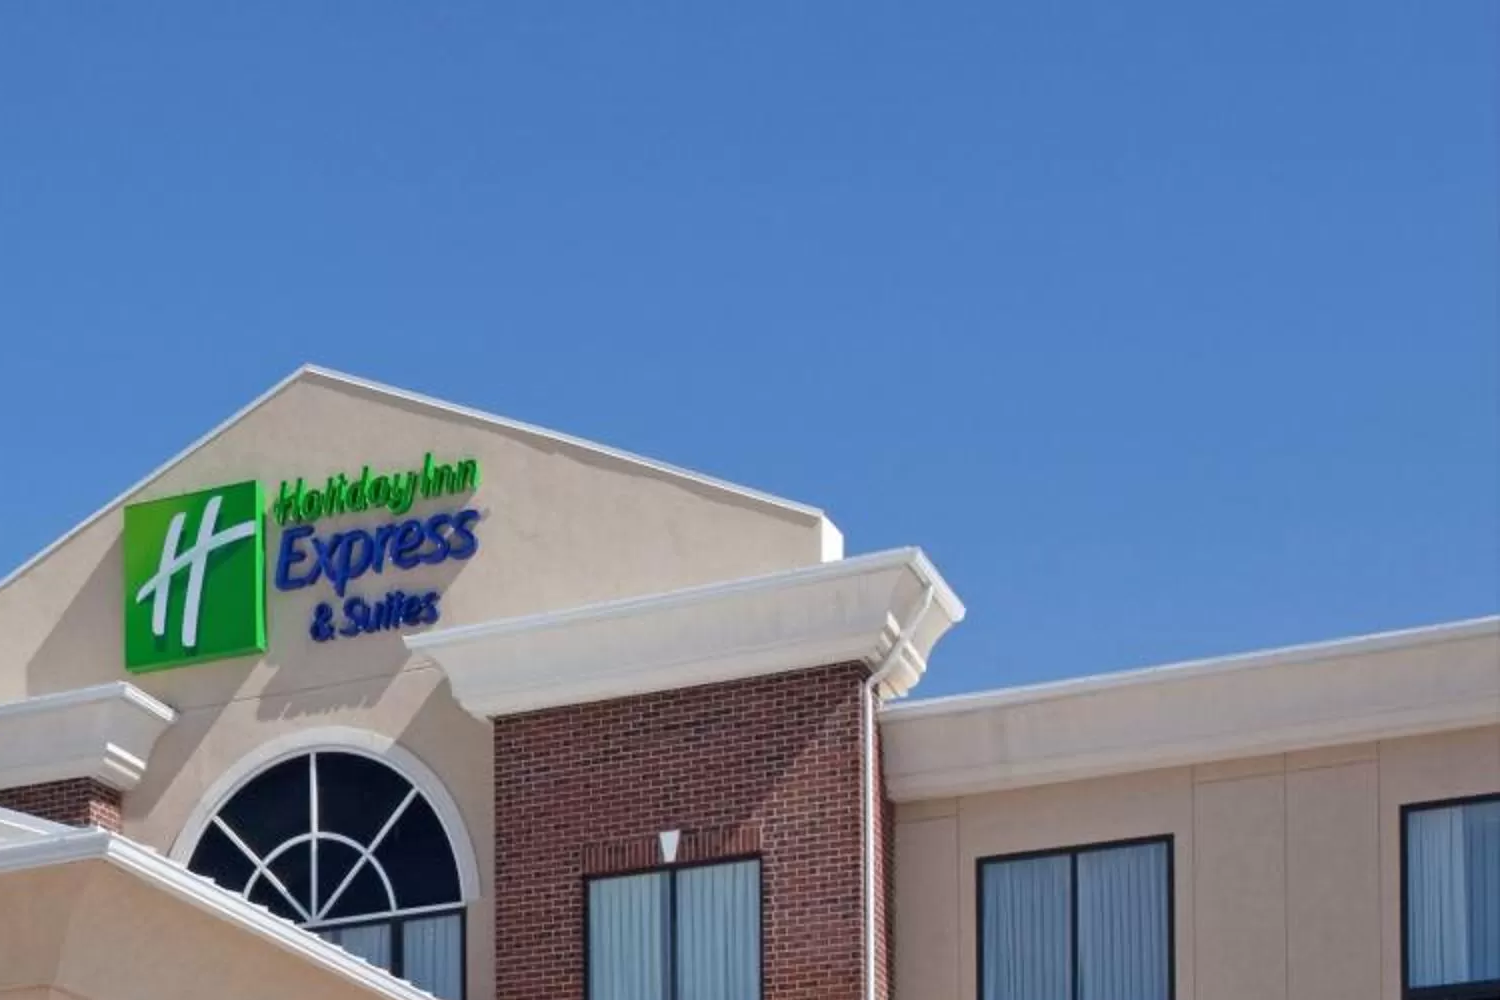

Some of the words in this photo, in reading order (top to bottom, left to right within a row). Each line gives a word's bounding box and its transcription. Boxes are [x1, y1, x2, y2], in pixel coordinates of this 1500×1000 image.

[273, 465, 418, 526] Holiday
[420, 452, 479, 498] Inn
[136, 495, 255, 647] H
[275, 509, 480, 597] Express
[310, 602, 335, 641] &
[340, 591, 440, 637] Suites
